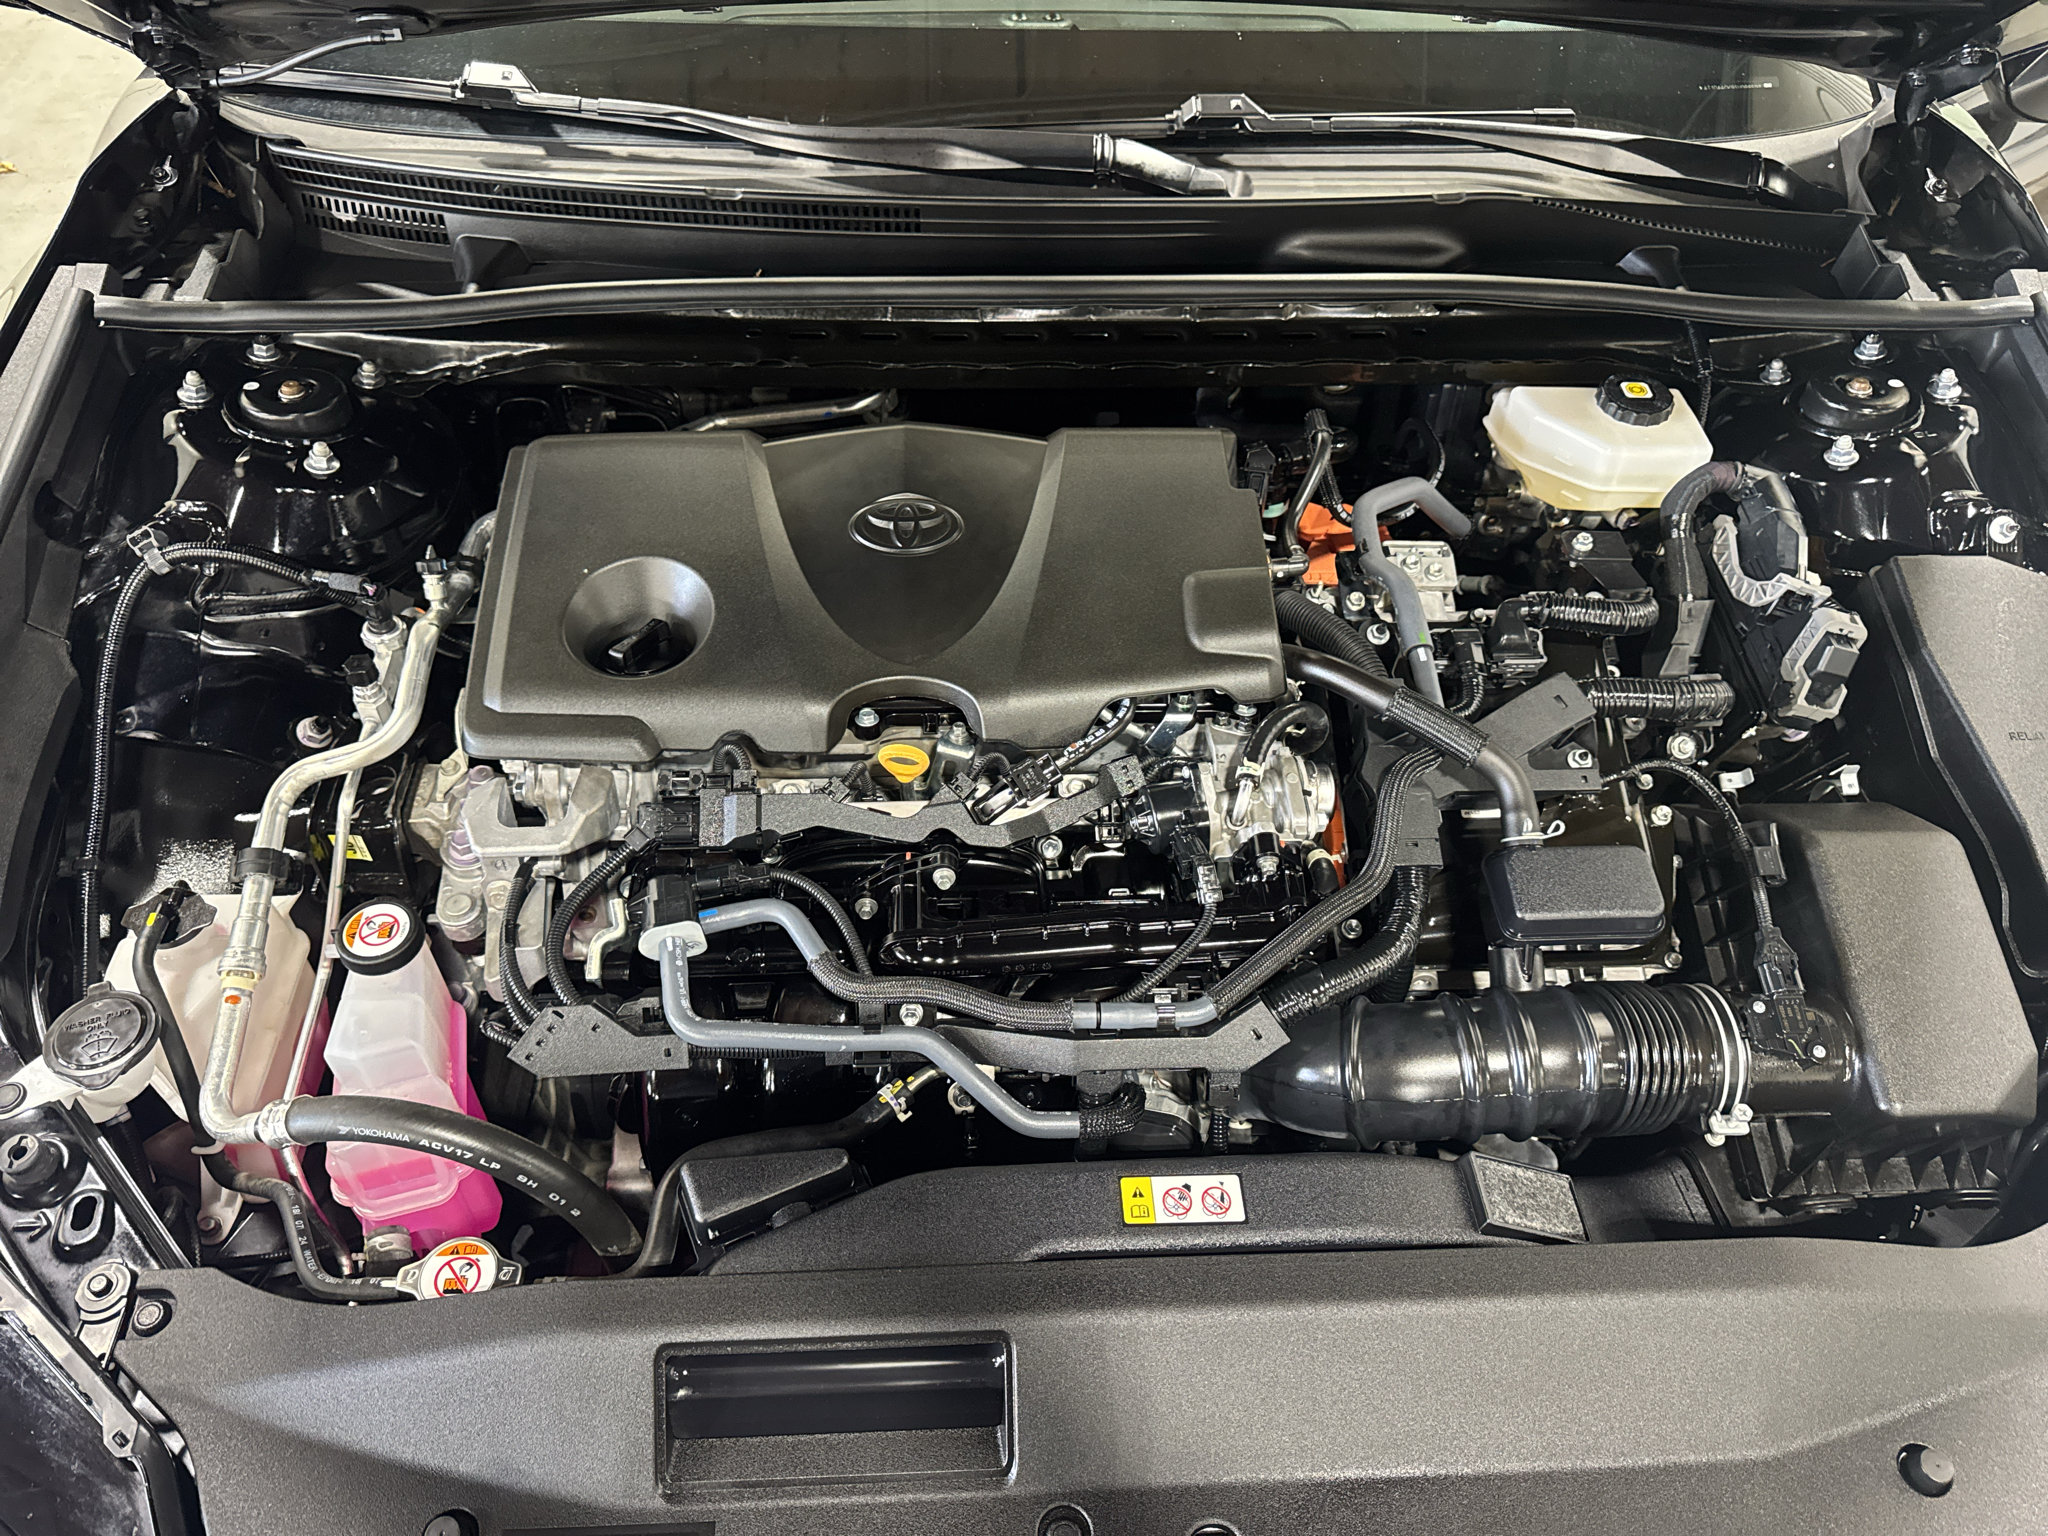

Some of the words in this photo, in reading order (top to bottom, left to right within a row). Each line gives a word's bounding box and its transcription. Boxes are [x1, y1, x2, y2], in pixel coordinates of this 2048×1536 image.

[64, 1016, 102, 1032] WASHER
[106, 1008, 131, 1020] FLUID
[86, 1020, 109, 1032] ONLY
[352, 1127, 410, 1143] YOKOHAMA
[418, 1138, 474, 1159] ACV17
[479, 1157, 502, 1170] LP
[303, 1249, 318, 1273] WATER
